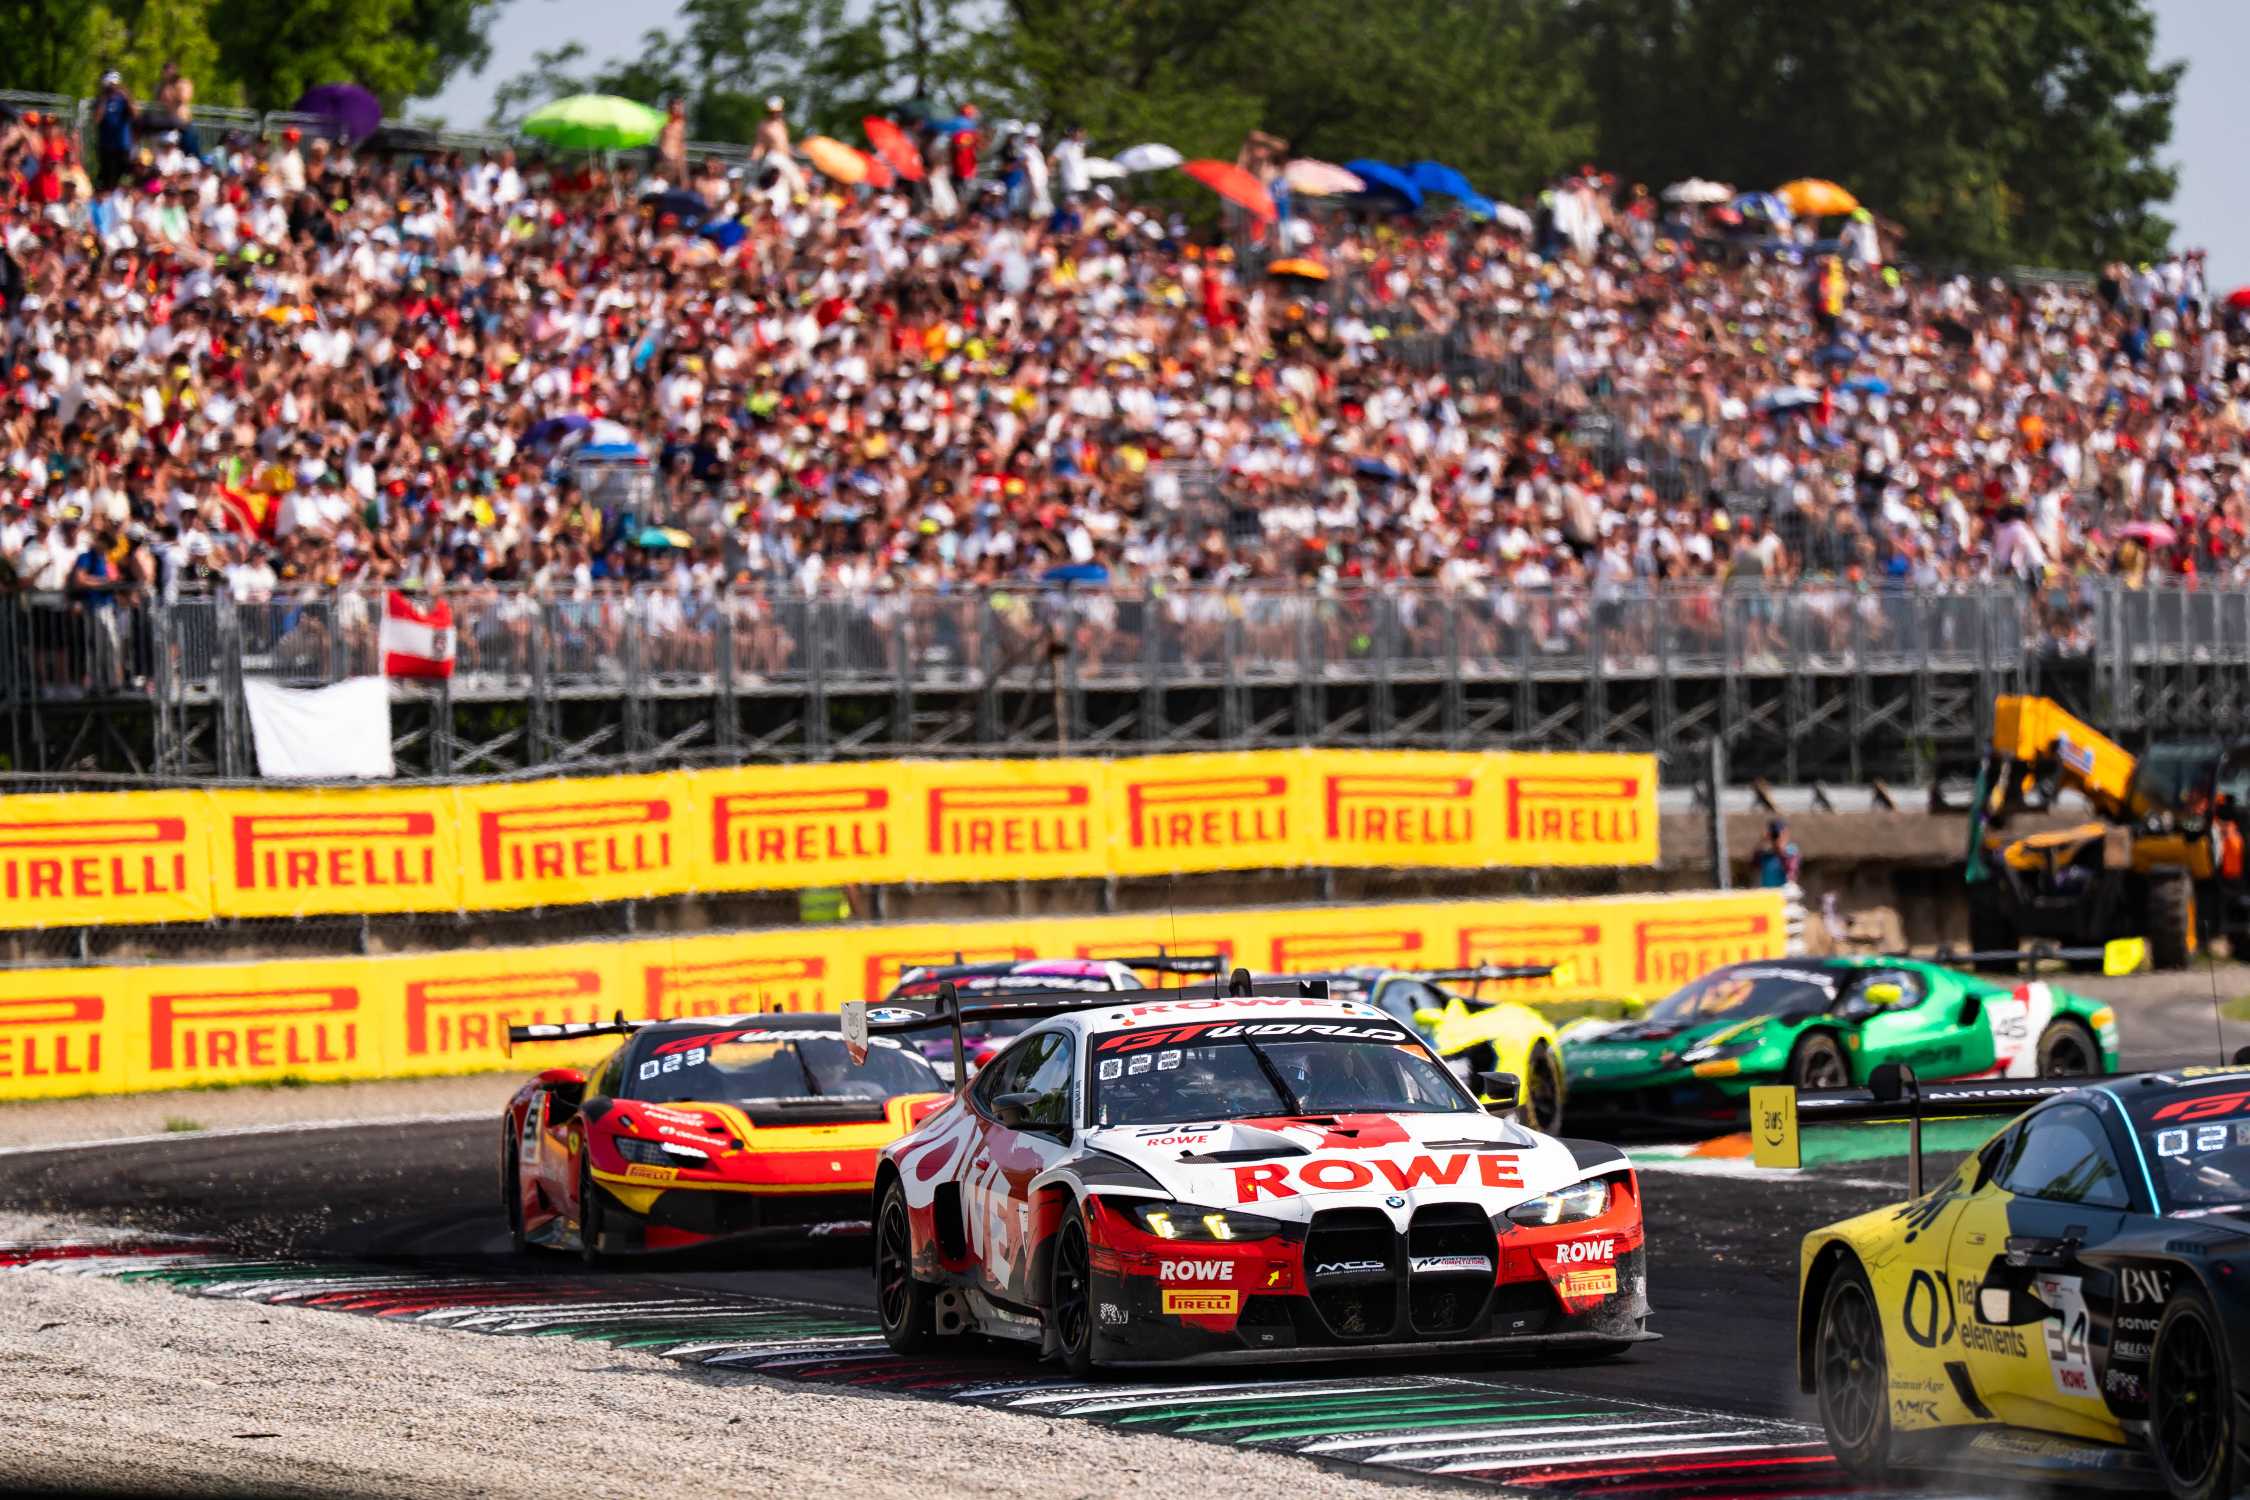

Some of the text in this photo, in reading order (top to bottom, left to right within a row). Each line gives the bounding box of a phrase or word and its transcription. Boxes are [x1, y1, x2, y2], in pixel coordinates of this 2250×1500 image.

[712, 787, 890, 865] PIRELLI
[927, 785, 1090, 855] PIRELLI
[1127, 775, 1288, 849] PIRELLI
[1325, 774, 1476, 842] PIRELLI
[1506, 776, 1640, 842] PIRELLI
[233, 812, 435, 890] PIRELLI
[479, 800, 671, 883] PIRELLI
[150, 986, 360, 1071] PIRELLI
[1096, 1020, 1240, 1053] GT
[1206, 1023, 1406, 1042] WORLD
[1147, 1135, 1209, 1147] ROWE
[1227, 1153, 1525, 1204] ROWE
[1159, 1260, 1235, 1281] ROWE
[1556, 1239, 1615, 1264] ROWE
[1168, 1294, 1231, 1309] PIRELLI
[1564, 1274, 1612, 1292] PIRELLI
[1961, 1316, 2028, 1359] elements
